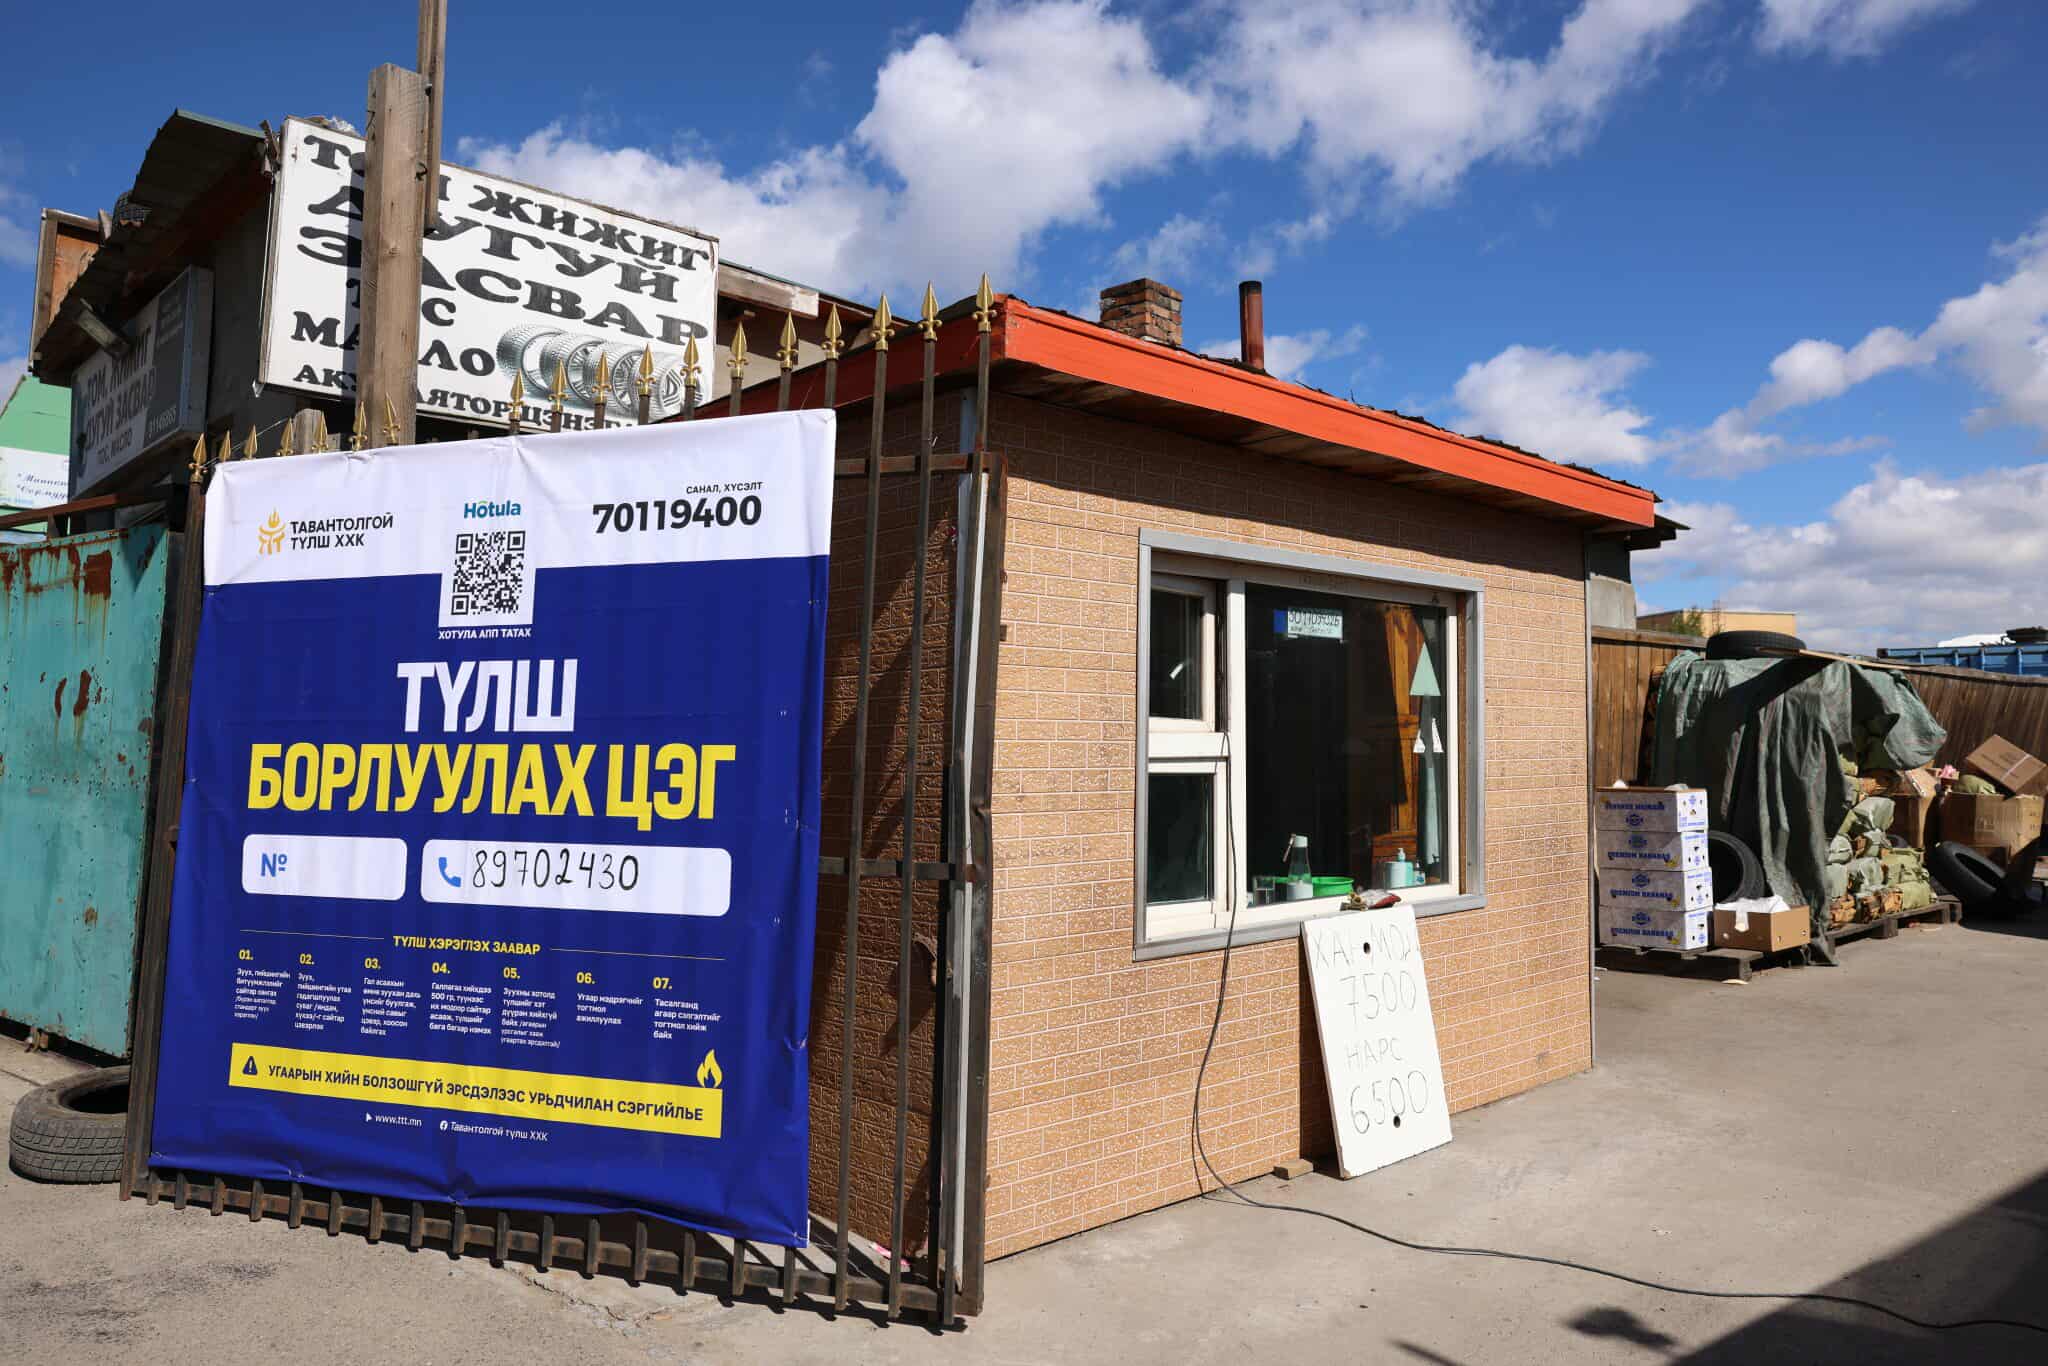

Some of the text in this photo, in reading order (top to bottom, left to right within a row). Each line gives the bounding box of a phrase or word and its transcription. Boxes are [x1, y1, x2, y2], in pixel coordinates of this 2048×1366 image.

[467, 184, 710, 271] ЖИЖИГ
[686, 481, 763, 495] САНАЛ, ХҮСЭЛТ
[290, 511, 394, 534] ТАВАНТОЛГОЙ
[592, 494, 762, 534] 70119400
[291, 533, 365, 551] ТҮЛШ ХХК
[438, 626, 531, 640] ХОТУЛА АПП ТАТАХ
[396, 658, 579, 732] ТҮЛШ
[247, 742, 737, 831] БОРЛУУЛАХ ЦЭГ
[471, 848, 640, 891] 89702430
[392, 935, 541, 955] ТҮЛШ ХЭРЭГЛЭХ ЗААВАР
[239, 949, 254, 960] 01.
[299, 953, 315, 965] 02.
[364, 958, 381, 969] 03.
[432, 962, 451, 974] 04.
[503, 967, 520, 979] 05.
[576, 972, 596, 984] 06.
[652, 976, 673, 990] 07.
[431, 992, 445, 1000] 500
[1337, 969, 1417, 1031] 7500
[653, 1030, 673, 1039] байх
[1344, 1035, 1404, 1071] НАРС
[268, 1065, 704, 1122] УГААРЫН ХИЙН БОЛЗОШГҮЙ ЭРСДЭЛЭЭС УРЬДЧИЛАН СЭРГИЙЛЬЕ
[1350, 1069, 1429, 1135] 6500
[375, 1113, 422, 1128] www.ttt.mn
[451, 1121, 548, 1142] Тавантолгой түлш ХХК
